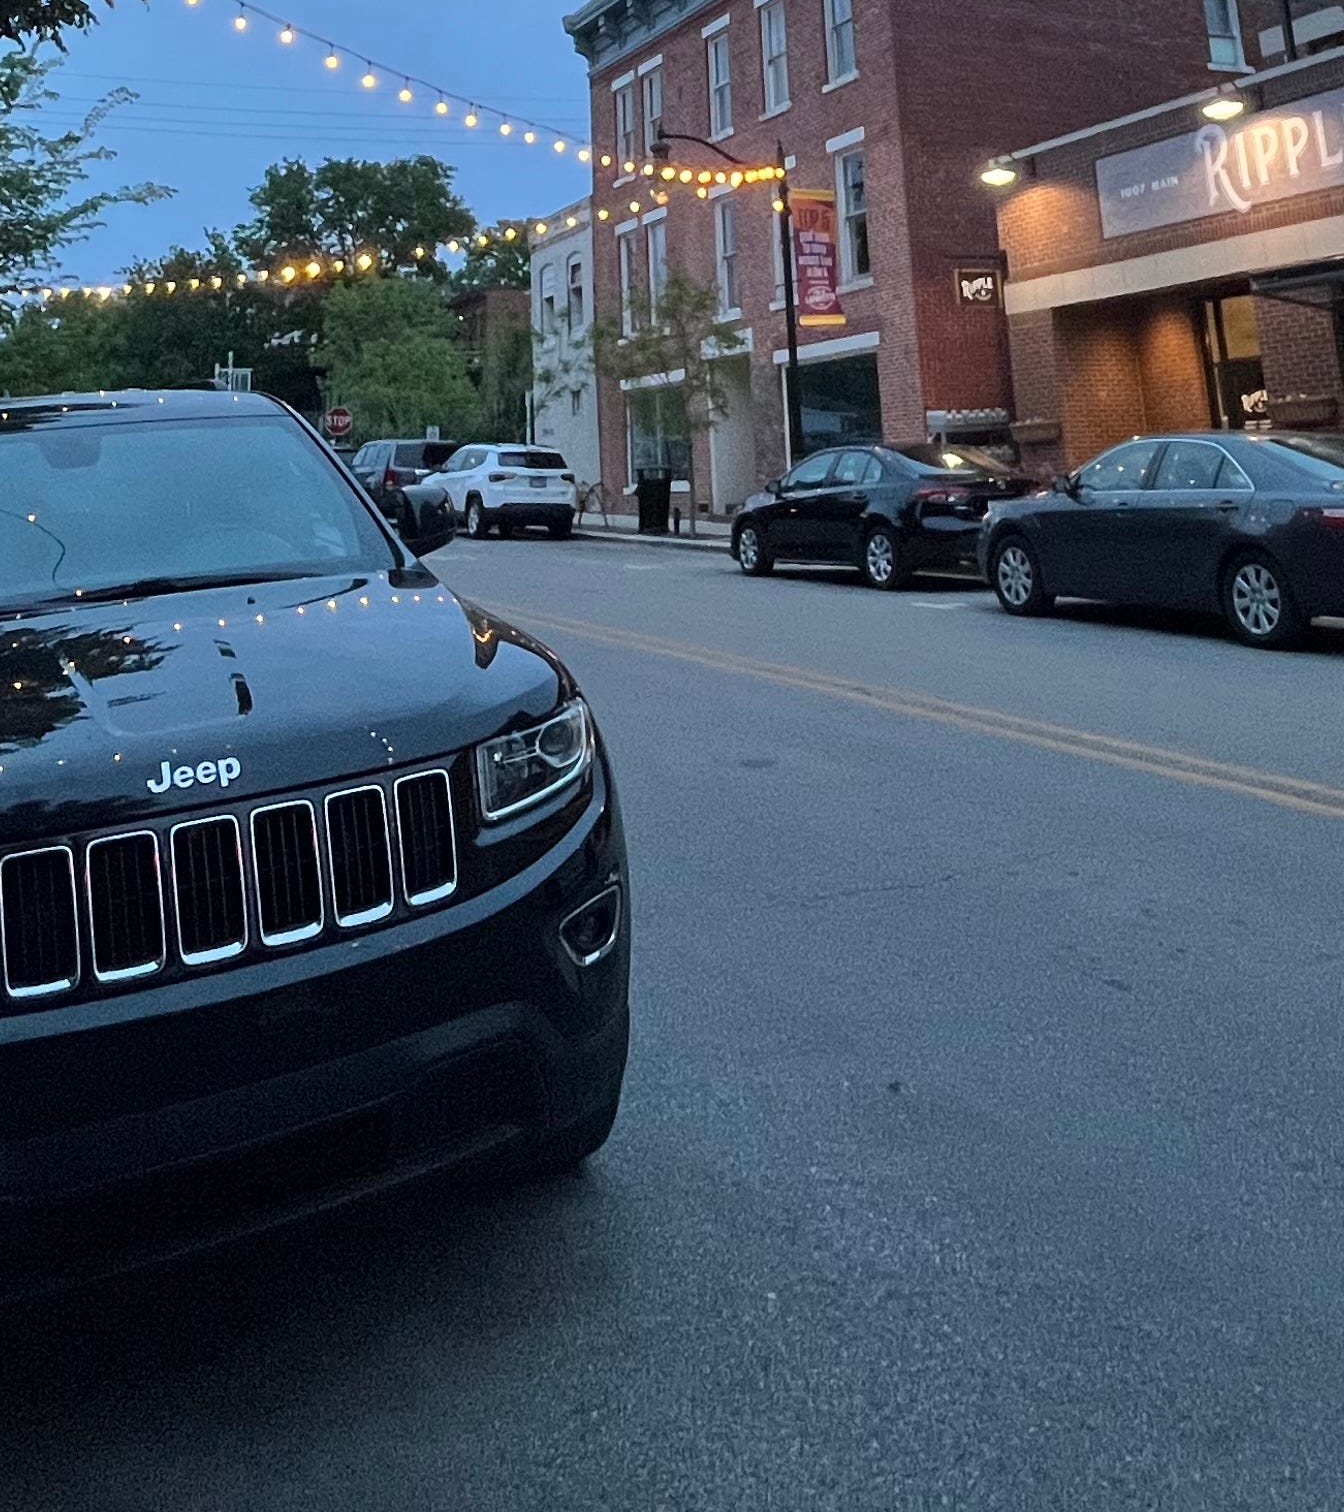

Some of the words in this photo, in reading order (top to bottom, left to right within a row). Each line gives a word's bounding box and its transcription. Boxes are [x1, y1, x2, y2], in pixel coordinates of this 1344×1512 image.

[1151, 176, 1179, 191] MAIN
[326, 415, 352, 426] STOP
[146, 757, 241, 793] Jeep
